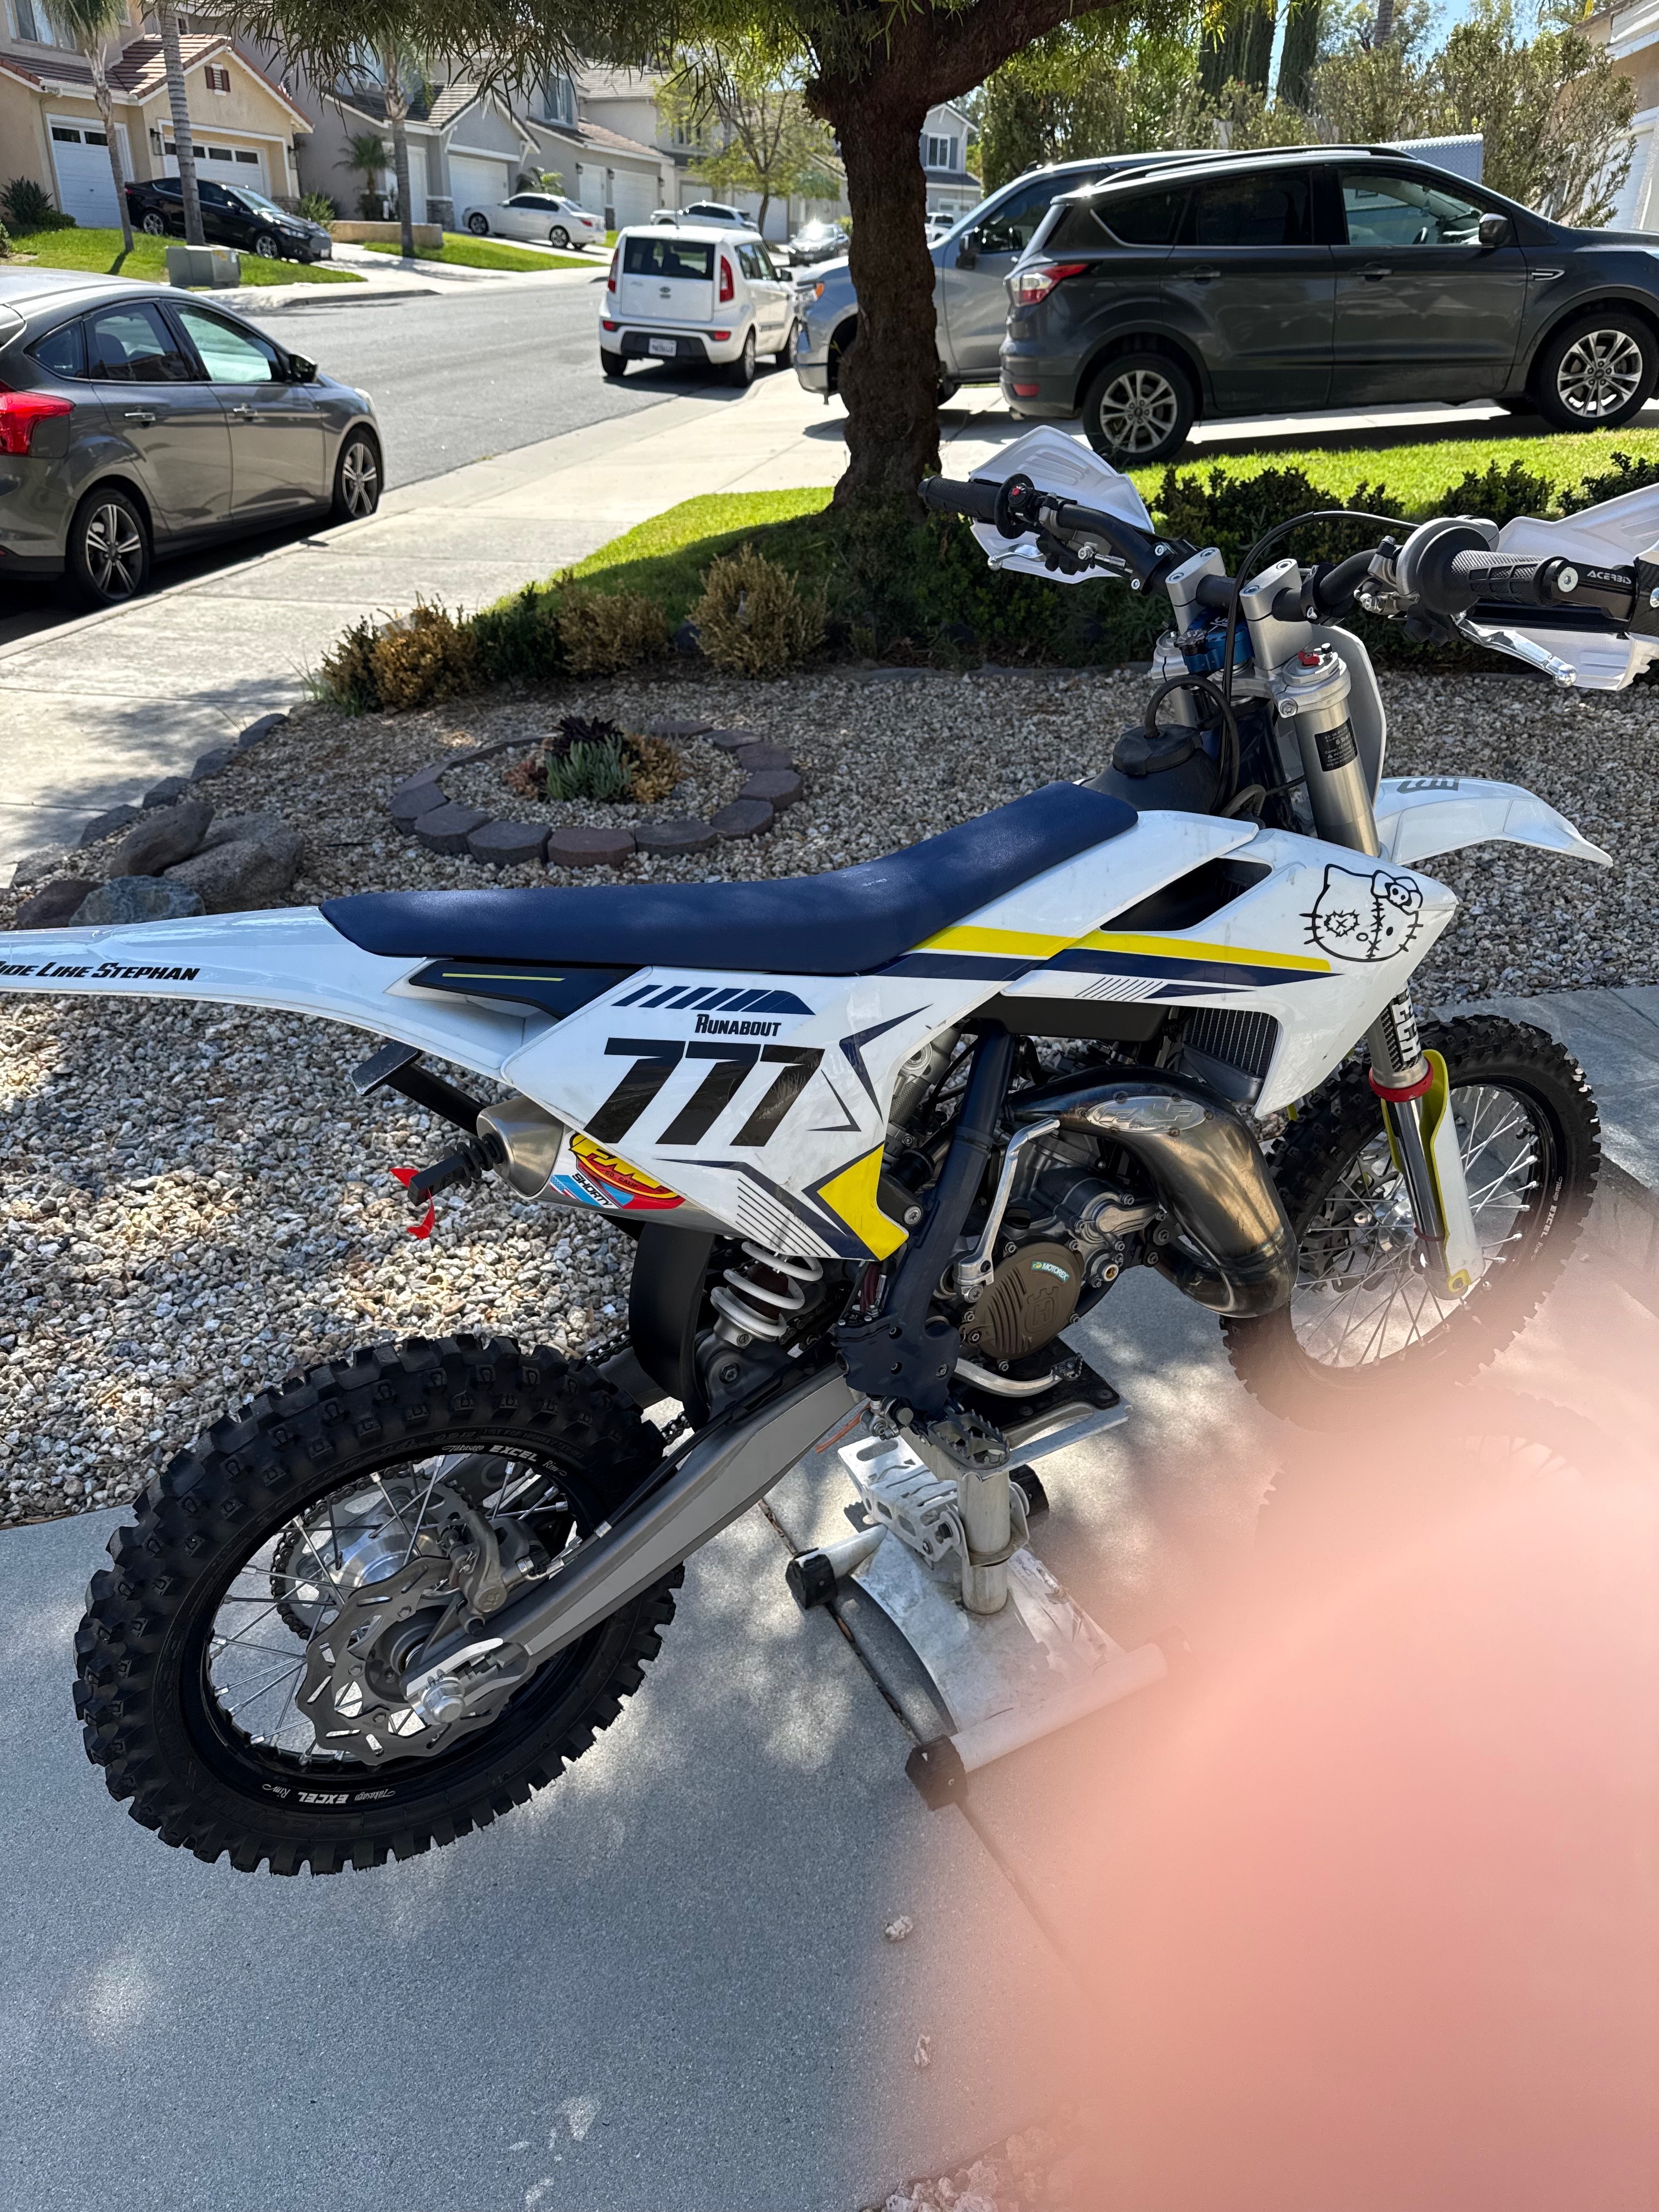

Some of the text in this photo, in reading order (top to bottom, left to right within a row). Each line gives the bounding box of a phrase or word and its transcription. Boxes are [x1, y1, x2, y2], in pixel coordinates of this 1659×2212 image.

[1587, 570, 1632, 584] ACERBIS
[36, 962, 94, 978] LIKE
[91, 962, 201, 981] STEPHAN
[695, 1014, 782, 1036] RUNABOUT
[584, 1037, 826, 1147] 777
[572, 1173, 613, 1206] SHORTY
[1540, 1205, 1558, 1238] EXCEL
[1042, 1262, 1068, 1281] MOTOREX
[489, 1444, 538, 1462] EXCEL
[542, 1460, 568, 1476] Rim
[262, 1784, 396, 1804] Takasago EXCEL Rim
